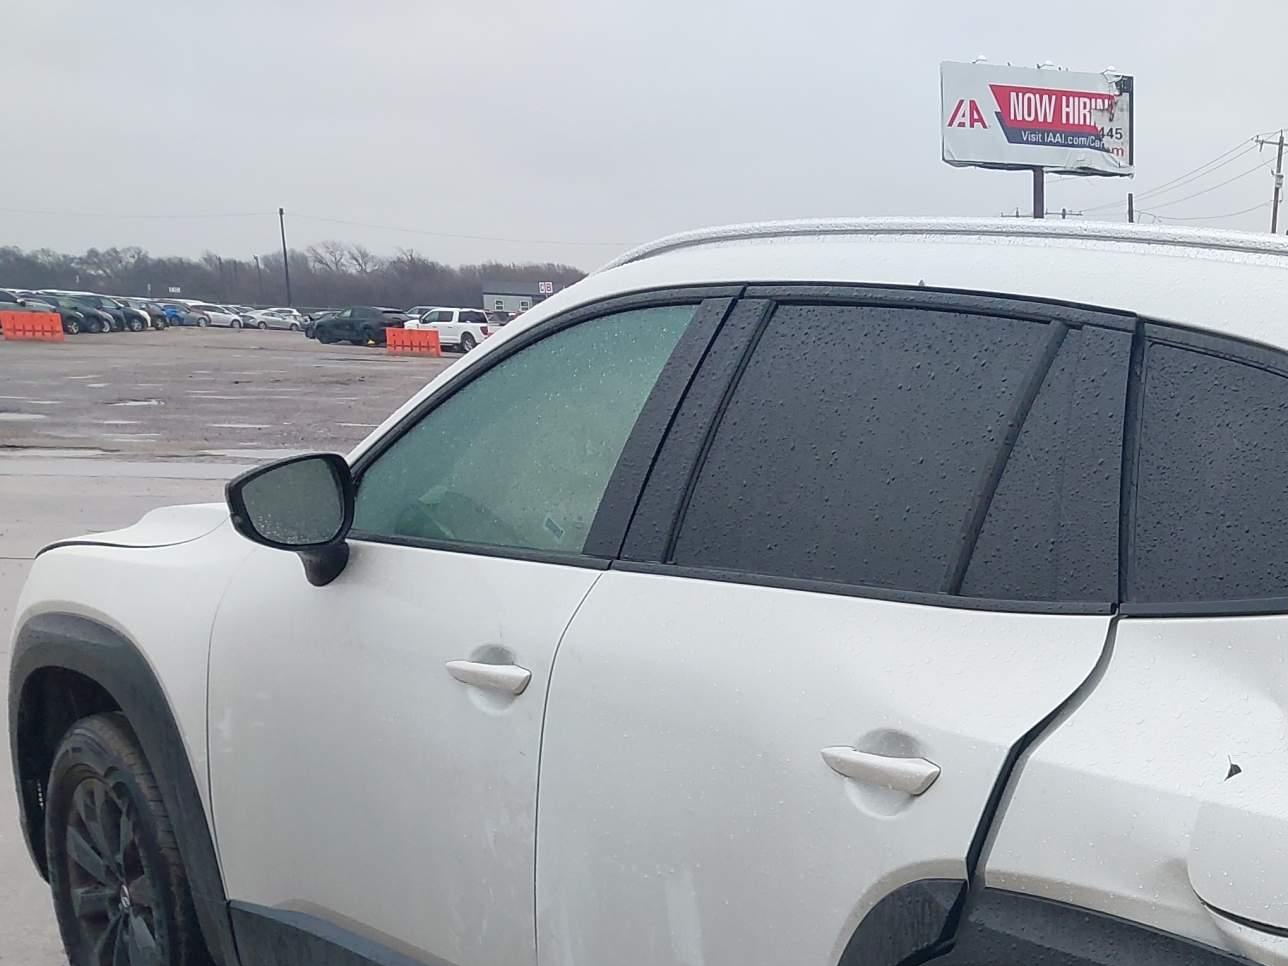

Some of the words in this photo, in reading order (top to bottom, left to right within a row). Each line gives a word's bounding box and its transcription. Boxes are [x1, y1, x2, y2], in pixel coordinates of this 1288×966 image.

[1010, 91, 1056, 122] NOW
[1061, 95, 1112, 127] HIRI
[1021, 130, 1042, 143] Visit
